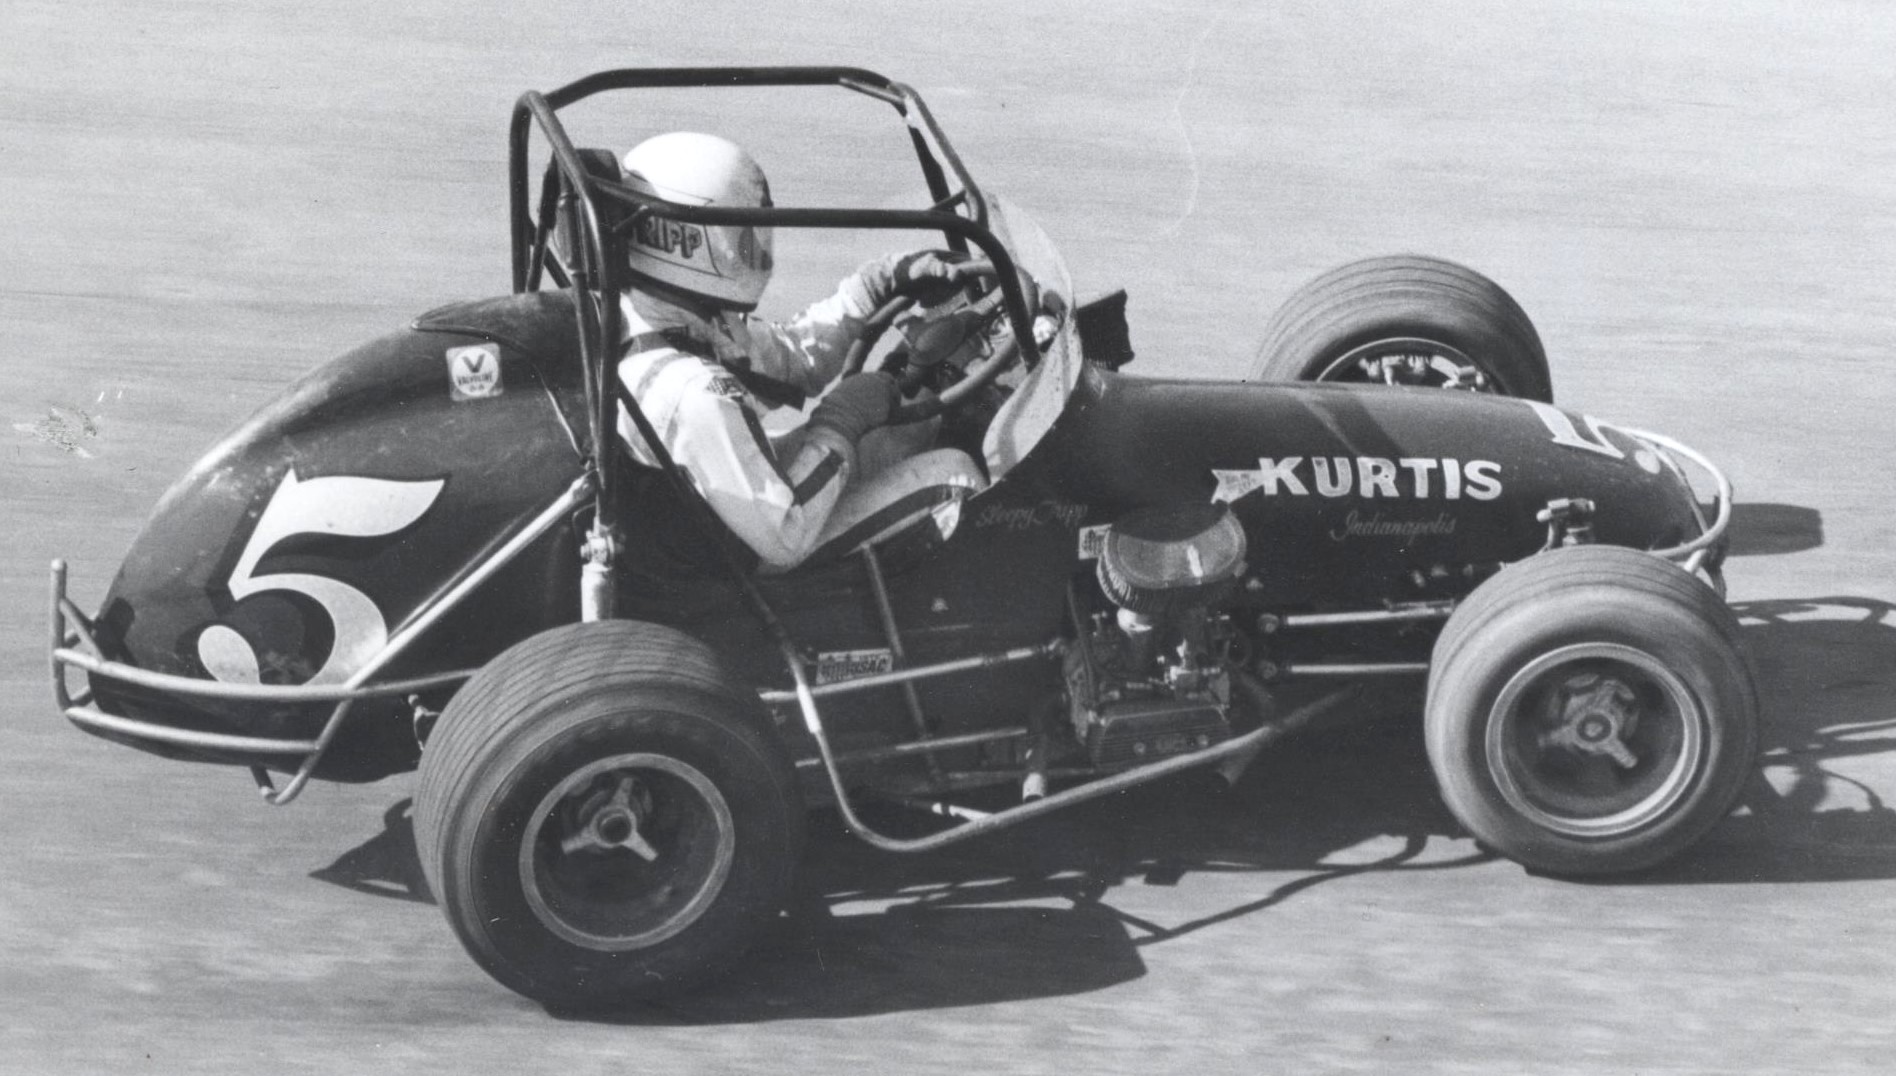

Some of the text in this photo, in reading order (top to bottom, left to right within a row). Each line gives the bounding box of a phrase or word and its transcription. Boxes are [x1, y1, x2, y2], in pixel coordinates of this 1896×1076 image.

[461, 353, 486, 373] V
[1257, 456, 1502, 501] KURTIS
[1329, 509, 1457, 546] Indianapolis
[198, 468, 445, 687] 5
